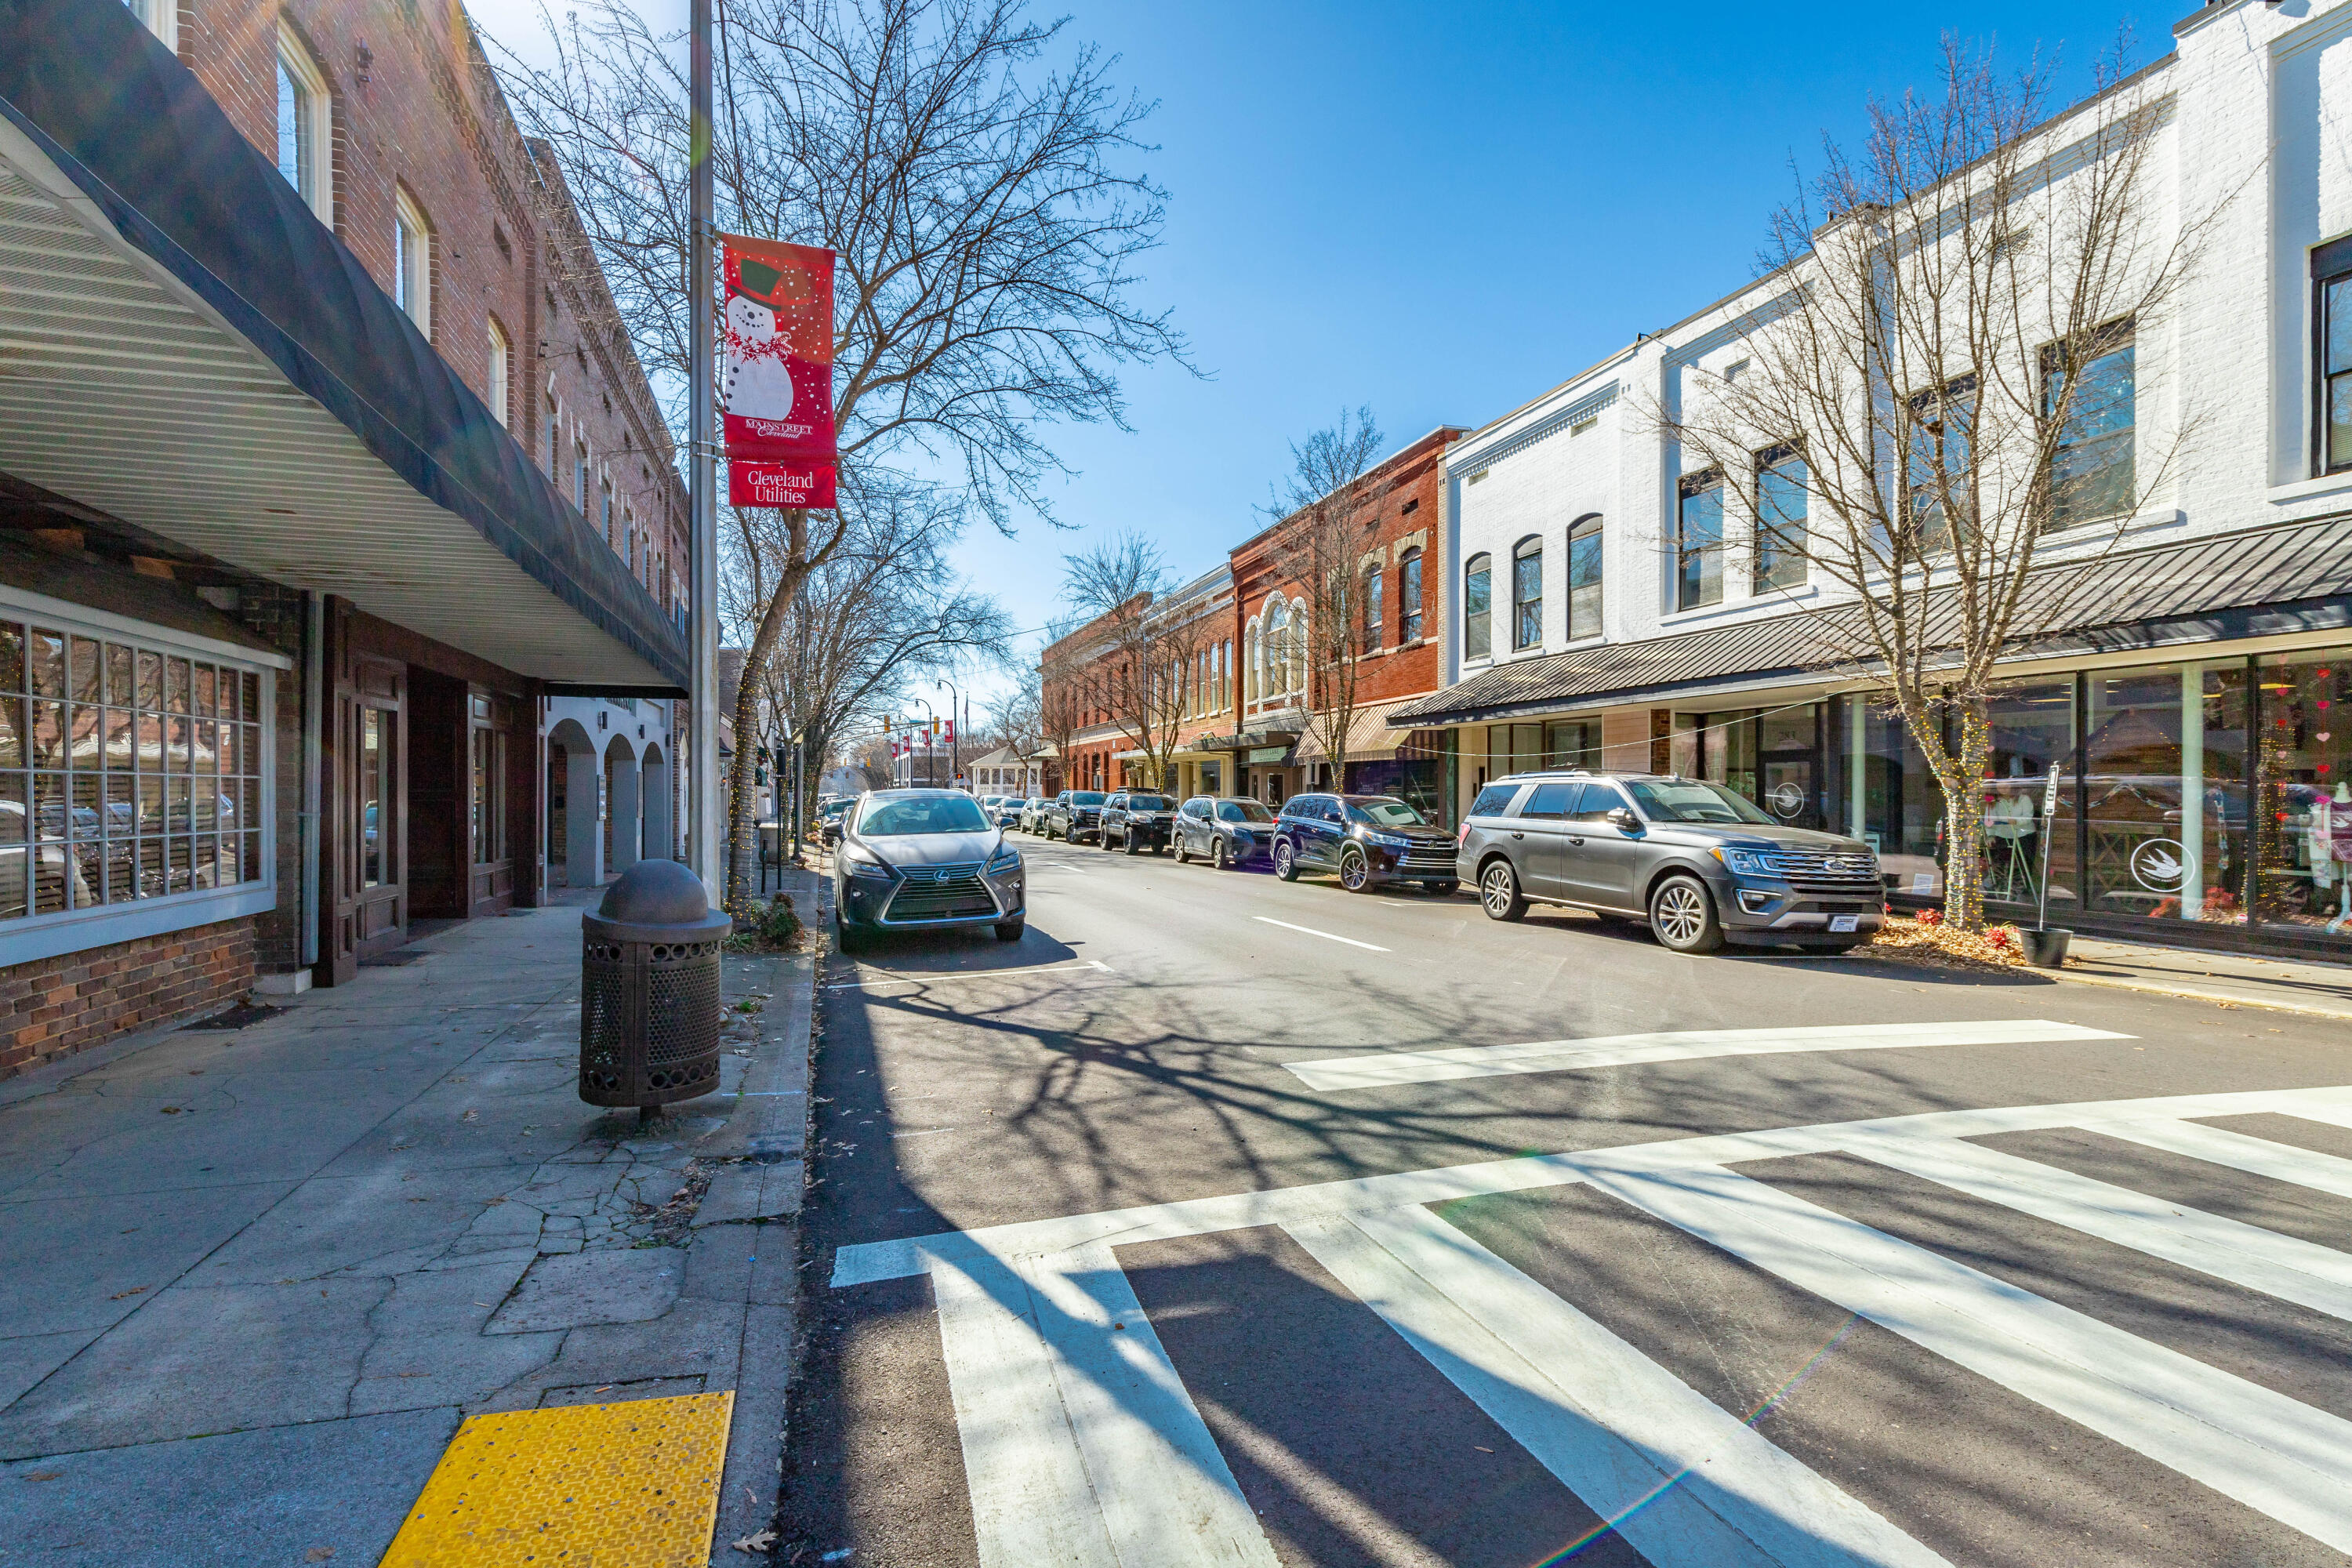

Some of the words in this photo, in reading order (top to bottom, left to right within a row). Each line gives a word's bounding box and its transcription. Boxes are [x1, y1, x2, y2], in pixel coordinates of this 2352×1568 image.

[746, 419, 813, 434] MAINSTREET
[757, 426, 803, 439] Cleveland
[748, 470, 814, 488] Cleveland
[756, 486, 806, 503] Utilities
